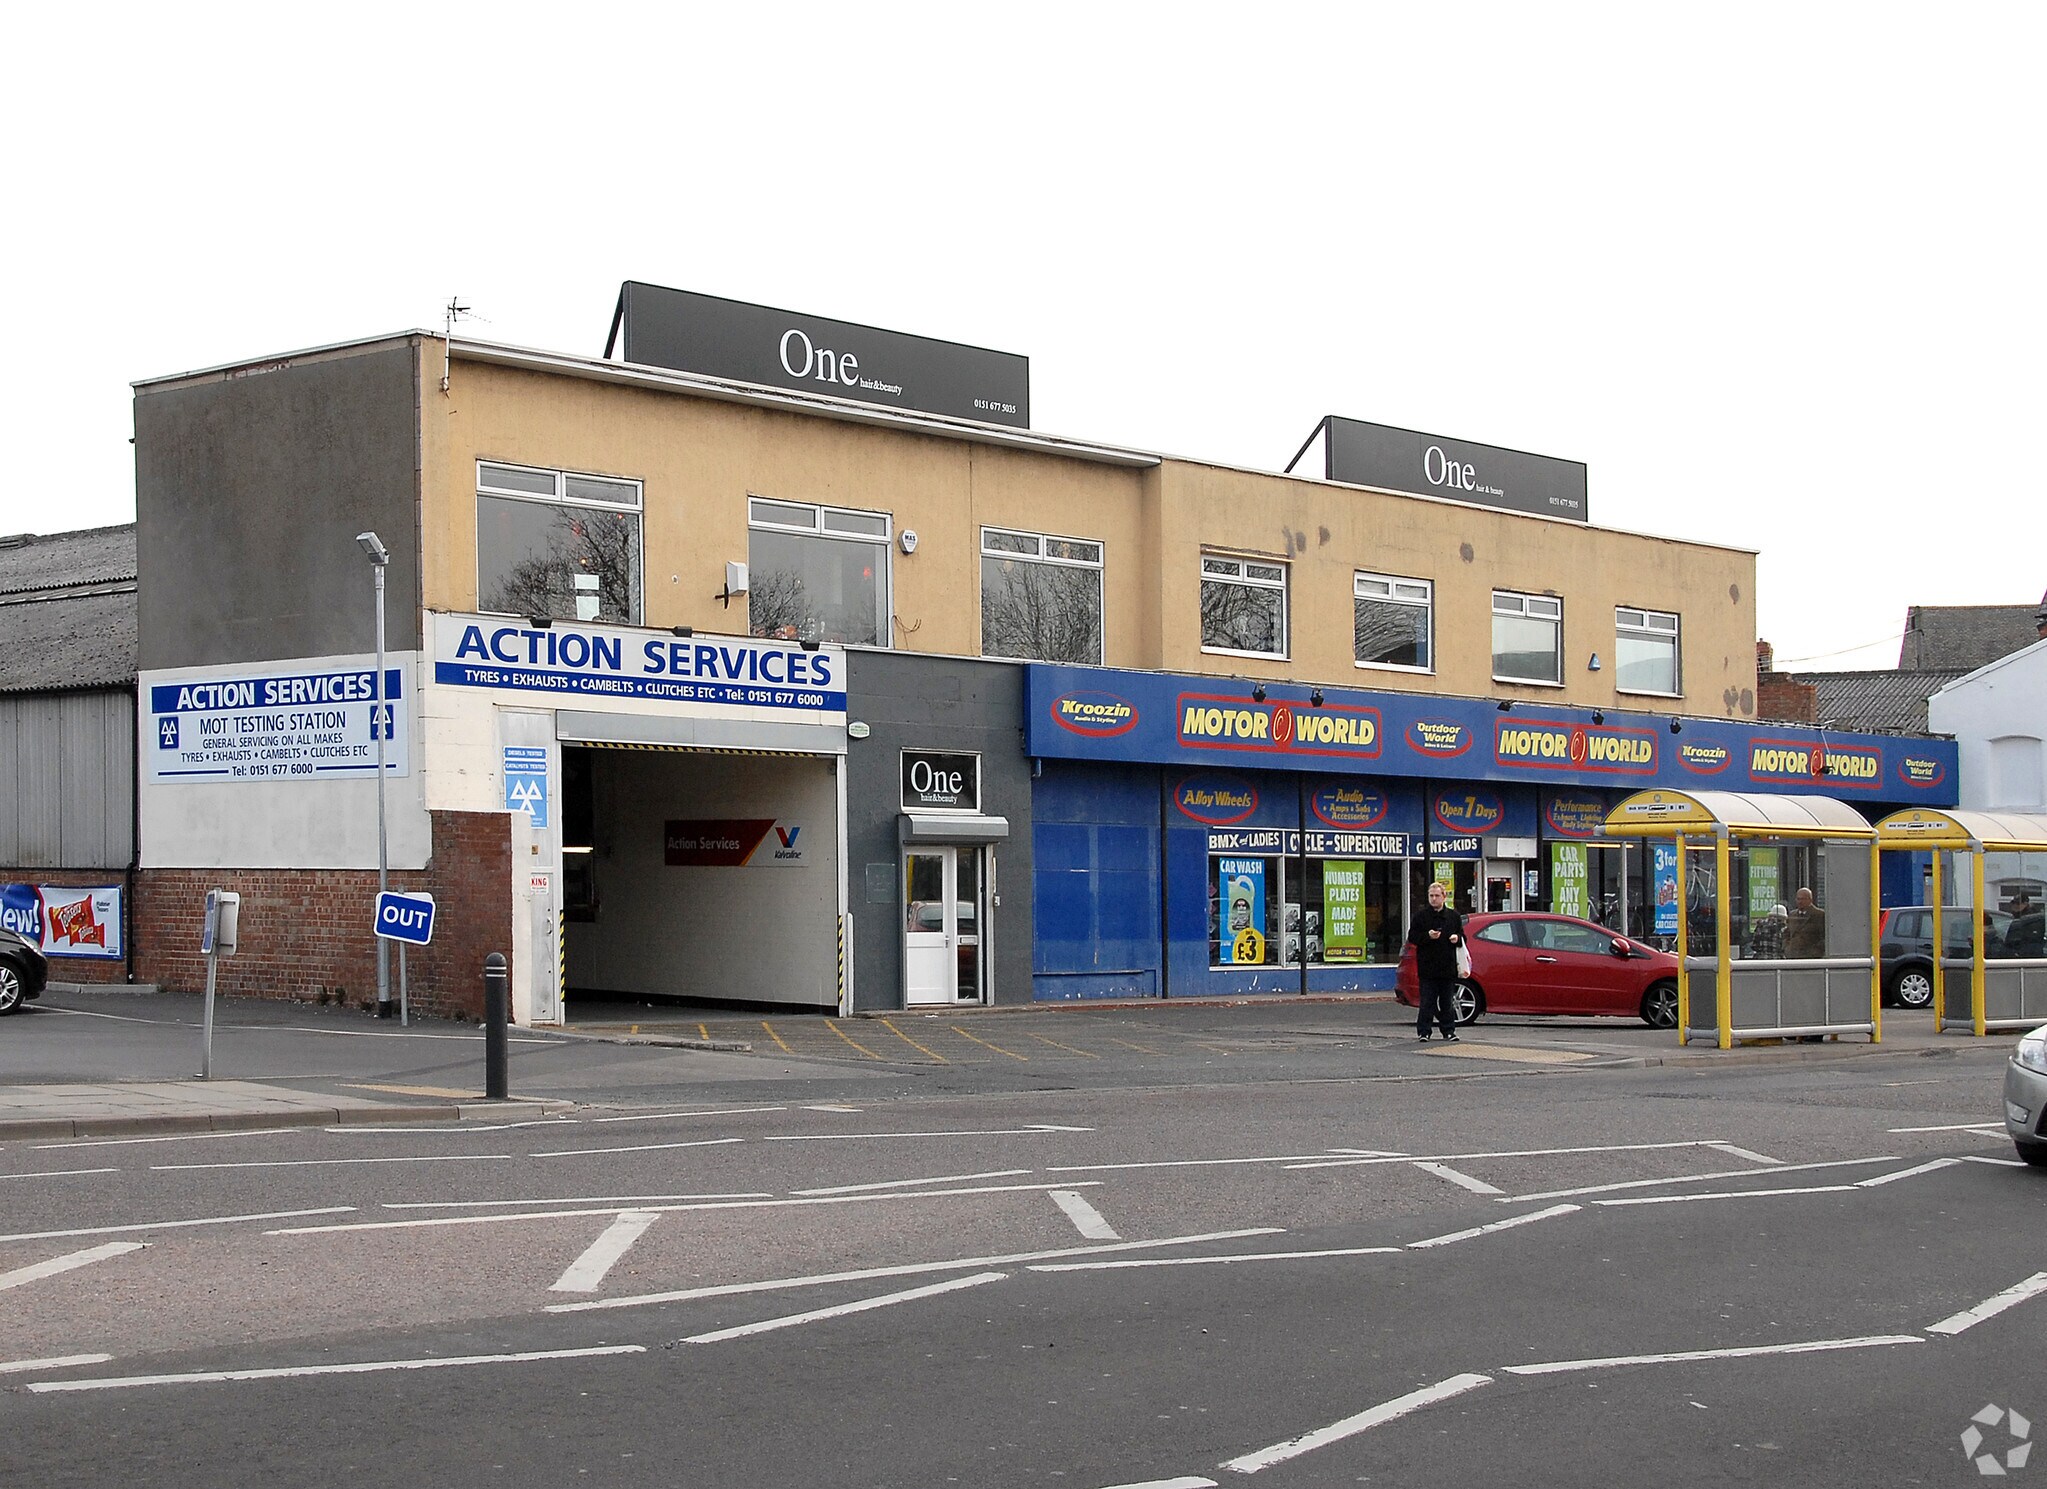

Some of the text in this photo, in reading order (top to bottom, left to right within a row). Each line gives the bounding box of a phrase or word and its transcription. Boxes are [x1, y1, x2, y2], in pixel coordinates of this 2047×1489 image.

[779, 328, 860, 386] One
[860, 377, 903, 396] hair&beauty
[974, 398, 1016, 414] 0151 677 5035
[1423, 445, 1476, 491] One
[455, 625, 831, 686] ACTION SERVICES
[176, 674, 371, 710] ACTION SERVICES
[465, 669, 823, 706] TYRES EXHAUSTS CAMBELTS CLUTCHES ETC Tel: 0151 677 6000
[1062, 700, 1130, 717] Kroozin
[200, 711, 346, 735] MOT TESTING STATION
[1183, 706, 1375, 745] MOTOR WORLD
[1417, 722, 1461, 734] Outdoor
[202, 733, 343, 749] GENERAL SERVICING ON ALL MAKES
[1424, 732, 1456, 743] World
[181, 746, 368, 763] TYRES EXHAUSTS CAMBELTS CLUTCHES ETC
[1499, 730, 1653, 764] MOTOR WORLD
[1682, 746, 1726, 758] Kroozin
[232, 764, 313, 777] Tel: 0151 677 6000
[1752, 748, 1877, 778] MOTOR WORLD
[1906, 759, 1936, 768] Outdoor
[1910, 766, 1932, 775] World
[910, 760, 963, 795] One
[920, 792, 958, 805] hair&beauty
[1183, 790, 1251, 808] Alloy Wheels
[1336, 788, 1364, 803] Audio
[1440, 796, 1497, 820] Open 7 Days
[1554, 800, 1602, 812] Performance
[668, 837, 740, 850] Action Services
[1208, 834, 1240, 849] BMX
[1248, 832, 1280, 847] LADIES
[1334, 834, 1402, 854] SUPERSTORE
[1416, 841, 1448, 854] GNTS
[1454, 838, 1478, 852] KIDS
[774, 850, 802, 859] Valvoline
[1560, 846, 1578, 862] CAR
[1656, 848, 1677, 870] 3 for
[1220, 860, 1262, 874] CAR WASH
[1435, 868, 1452, 876] PARTS
[1554, 862, 1584, 878] PARTS
[1750, 866, 1776, 878] FITTING
[531, 878, 547, 886] KING
[1325, 871, 1363, 886] NUMBER
[1329, 888, 1360, 902] PLATES
[1560, 887, 1580, 902] ANY
[1752, 886, 1776, 898] WIPER
[0, 898, 40, 934] ew!
[383, 905, 428, 929] OUT
[1332, 906, 1356, 920] MADE
[1561, 902, 1579, 917] CAR
[1333, 922, 1354, 936] HERE
[1238, 936, 1257, 961] £3
